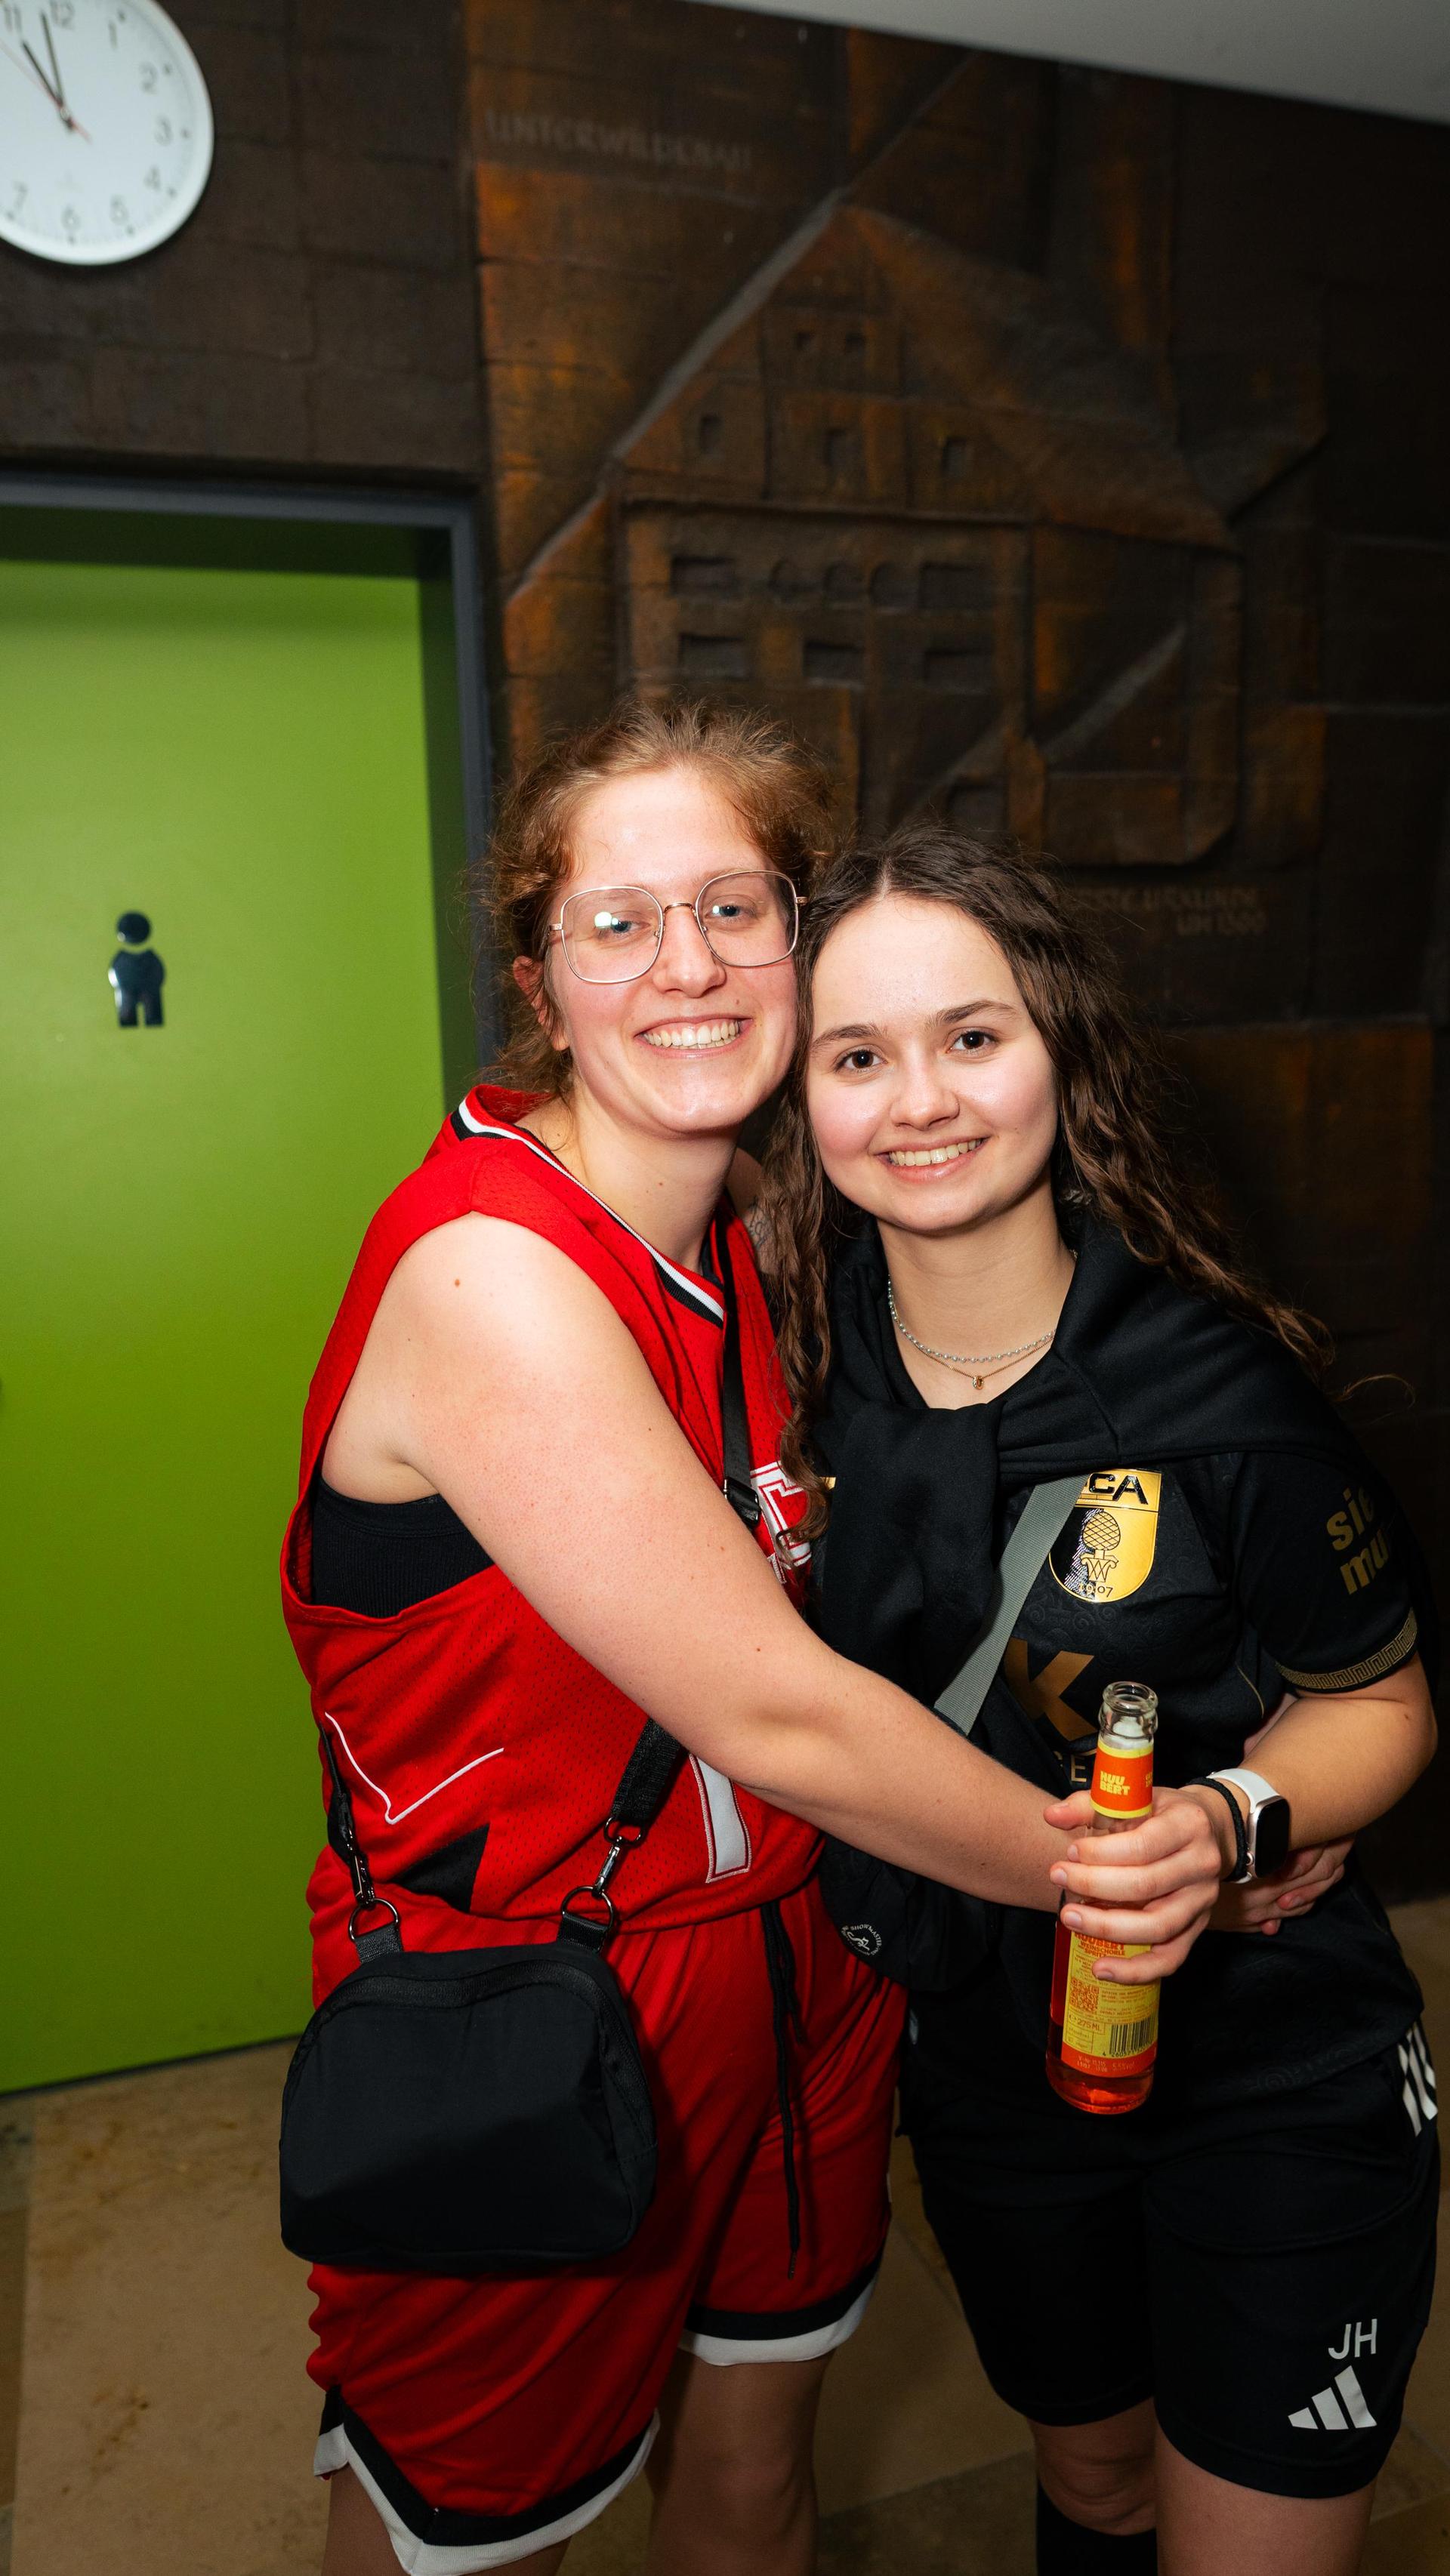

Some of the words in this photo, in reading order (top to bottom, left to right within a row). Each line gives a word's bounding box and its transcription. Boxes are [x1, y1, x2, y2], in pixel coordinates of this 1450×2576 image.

[49, 0, 76, 30] 12
[107, 17, 118, 50] 1
[139, 61, 159, 94] 2
[154, 116, 174, 146] 3
[144, 165, 162, 192] 4
[13, 179, 29, 211] 7
[61, 205, 80, 231] 6
[1083, 1471, 1149, 1505] CA
[1078, 1583, 1114, 1598] 1907
[1100, 1770, 1125, 1786] HUU
[1100, 1779, 1131, 1795] BERT
[1077, 2017, 1091, 2029] 275
[1328, 2318, 1378, 2360] JH
